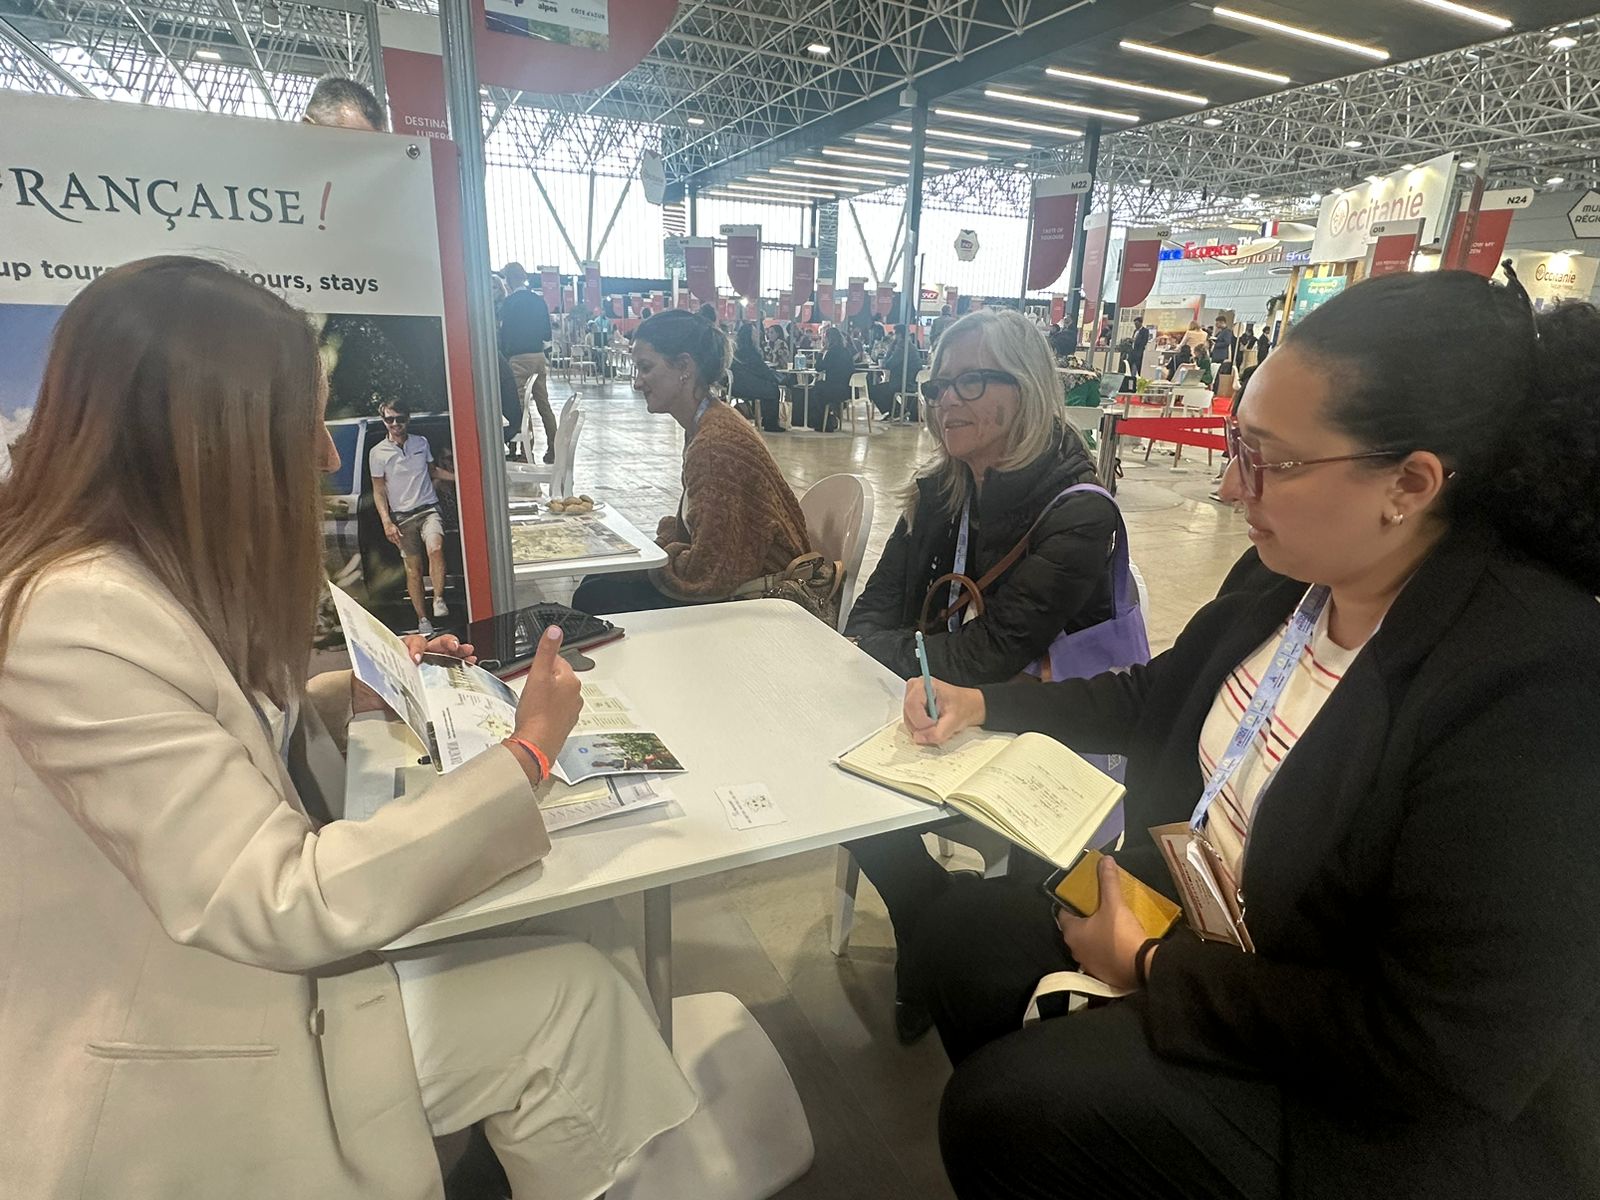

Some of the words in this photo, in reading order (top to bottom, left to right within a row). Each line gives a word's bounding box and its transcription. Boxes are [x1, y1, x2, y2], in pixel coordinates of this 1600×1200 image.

[537, 3, 558, 14] alpes
[404, 115, 448, 130] DESTINA
[1071, 181, 1088, 190] M22
[0, 167, 305, 231] RANÇAISE
[1506, 195, 1527, 205] N24
[1329, 186, 1424, 238] Occitanie
[1582, 204, 1600, 213] MU
[1574, 213, 1600, 223] RÉGI
[1535, 263, 1576, 283] Occitanie
[319, 274, 379, 293] stays
